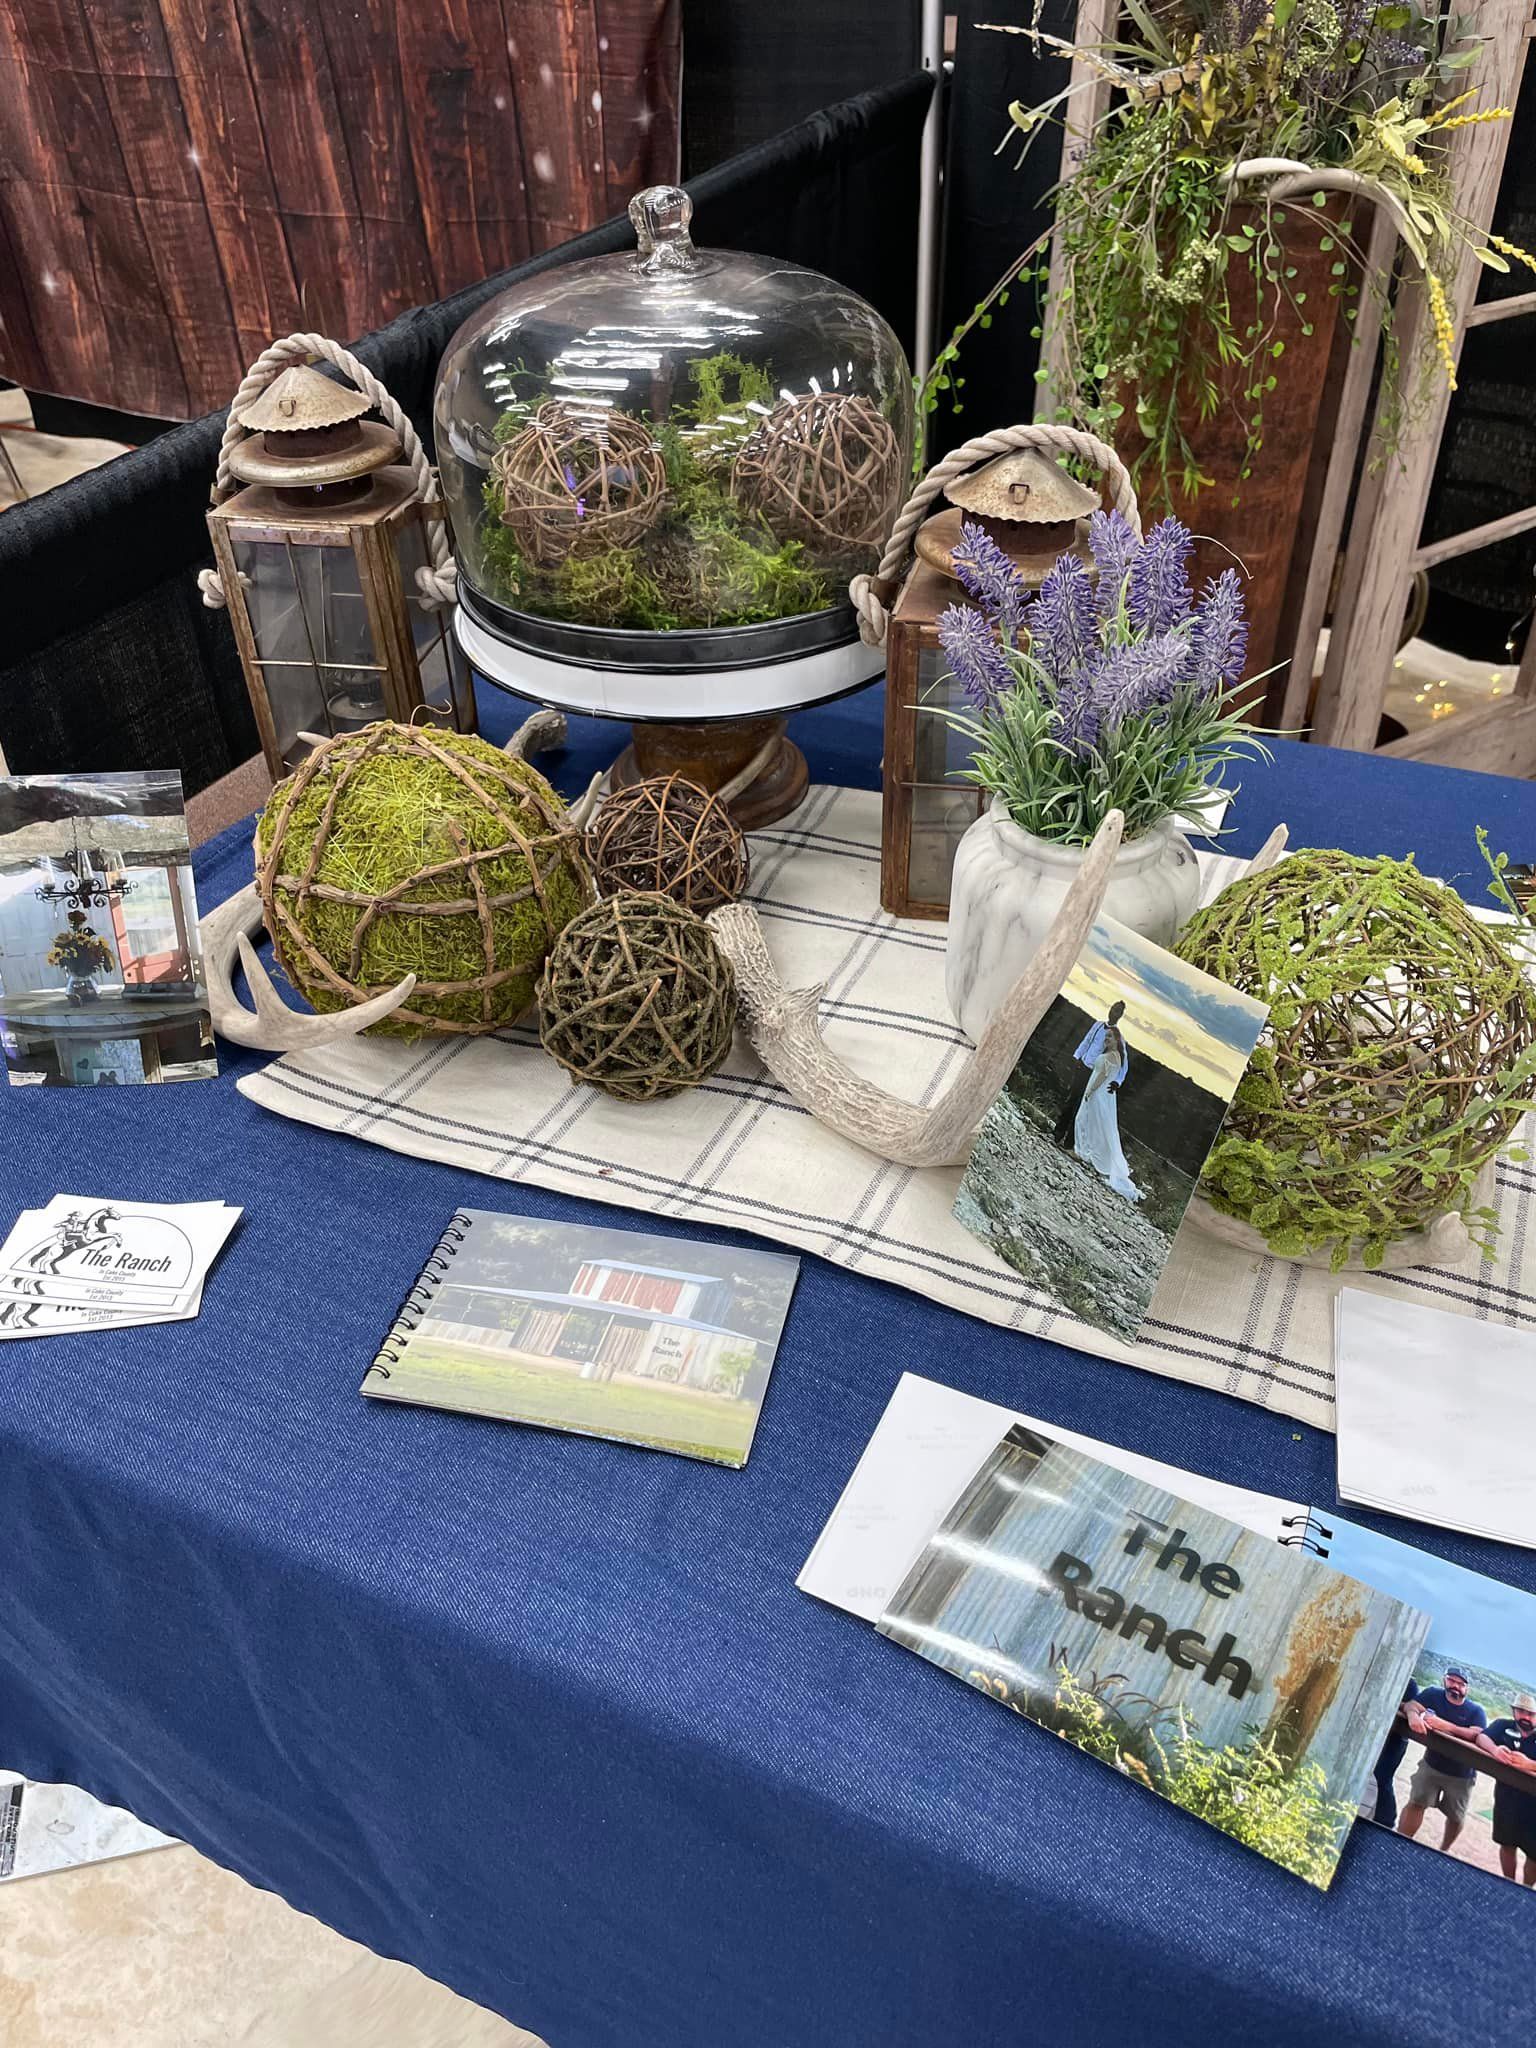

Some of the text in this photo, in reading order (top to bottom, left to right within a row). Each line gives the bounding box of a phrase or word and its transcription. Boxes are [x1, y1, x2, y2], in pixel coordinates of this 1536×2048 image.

[80, 1248, 172, 1272] The Ranch
[1124, 1509, 1241, 1600] The
[1050, 1551, 1253, 1701] Ranch
